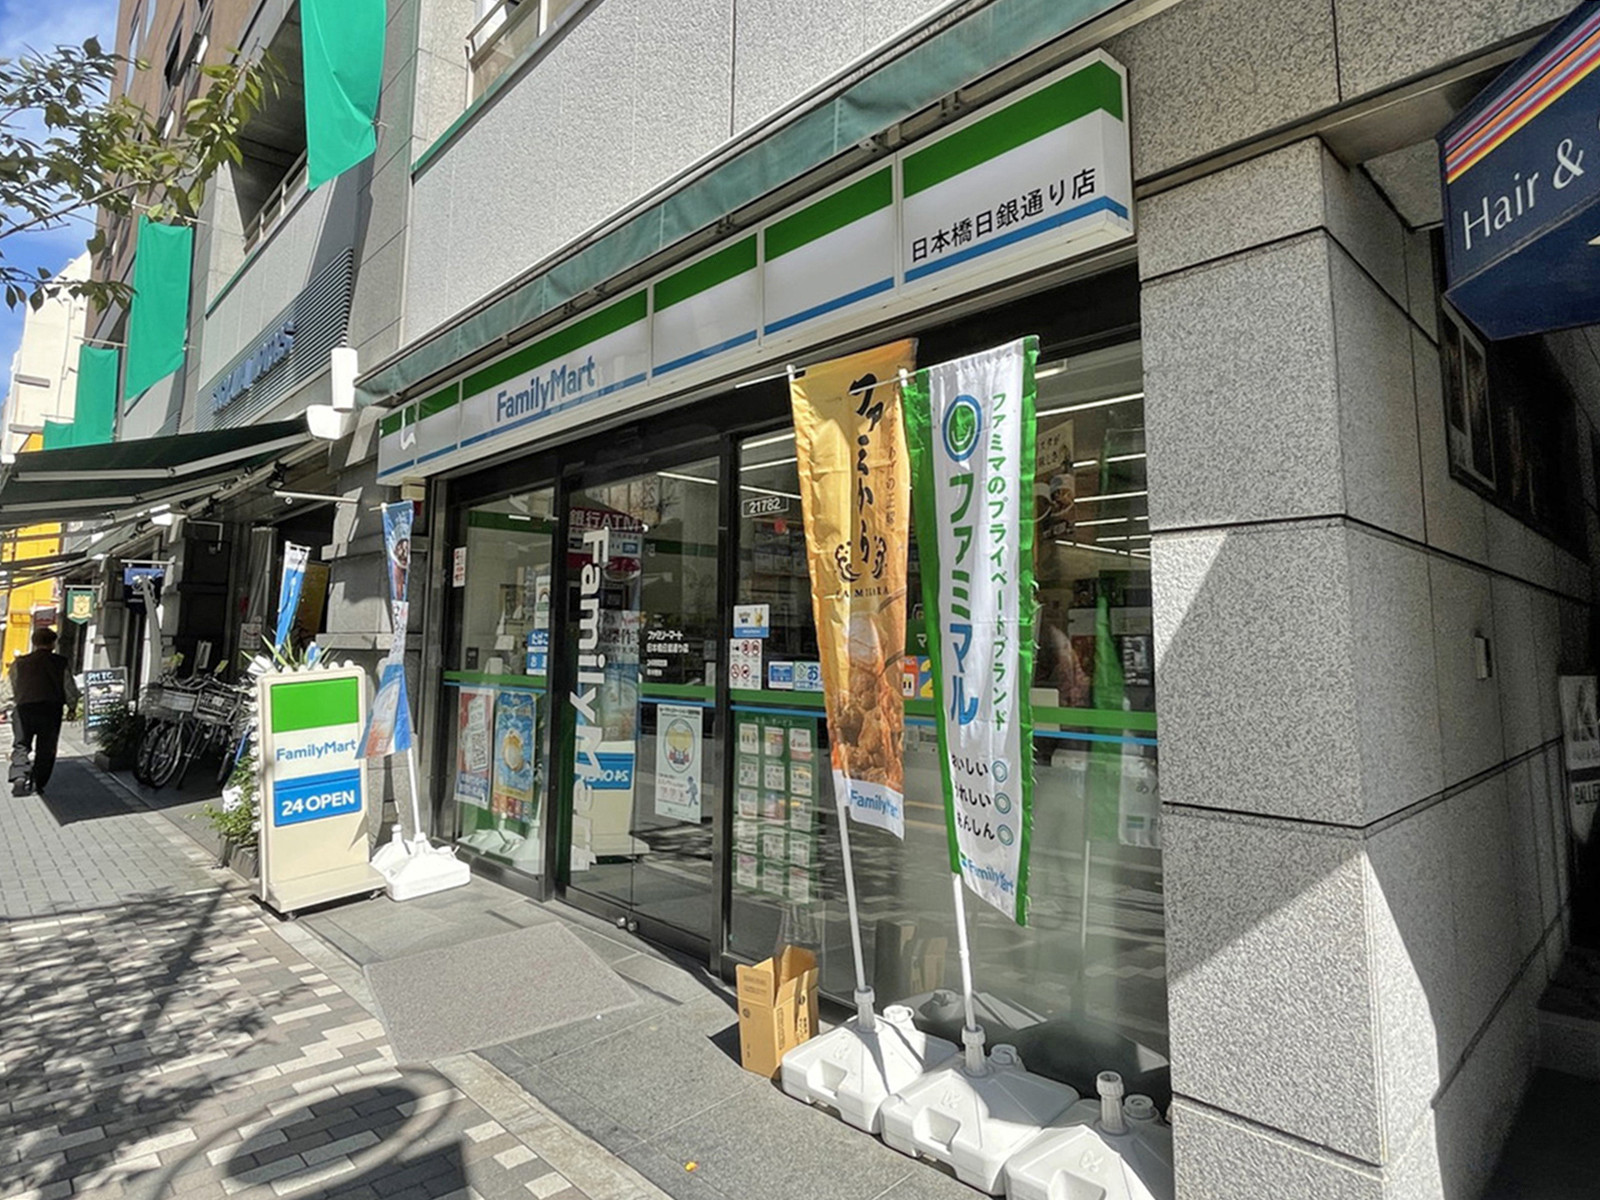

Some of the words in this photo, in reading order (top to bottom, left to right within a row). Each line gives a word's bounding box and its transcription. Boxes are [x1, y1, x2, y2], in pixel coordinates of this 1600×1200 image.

[912, 168, 1096, 262] 日本橋日銀通り店
[1463, 172, 1539, 250] Hair
[1553, 138, 1585, 189] &
[497, 355, 595, 422] FamilyMart
[749, 497, 780, 514] 21782
[949, 473, 978, 725] ファミマル
[988, 393, 1008, 731] ファミマのプライベートブランド
[570, 526, 609, 870] FamilyMart
[276, 739, 357, 762] FamilyMart
